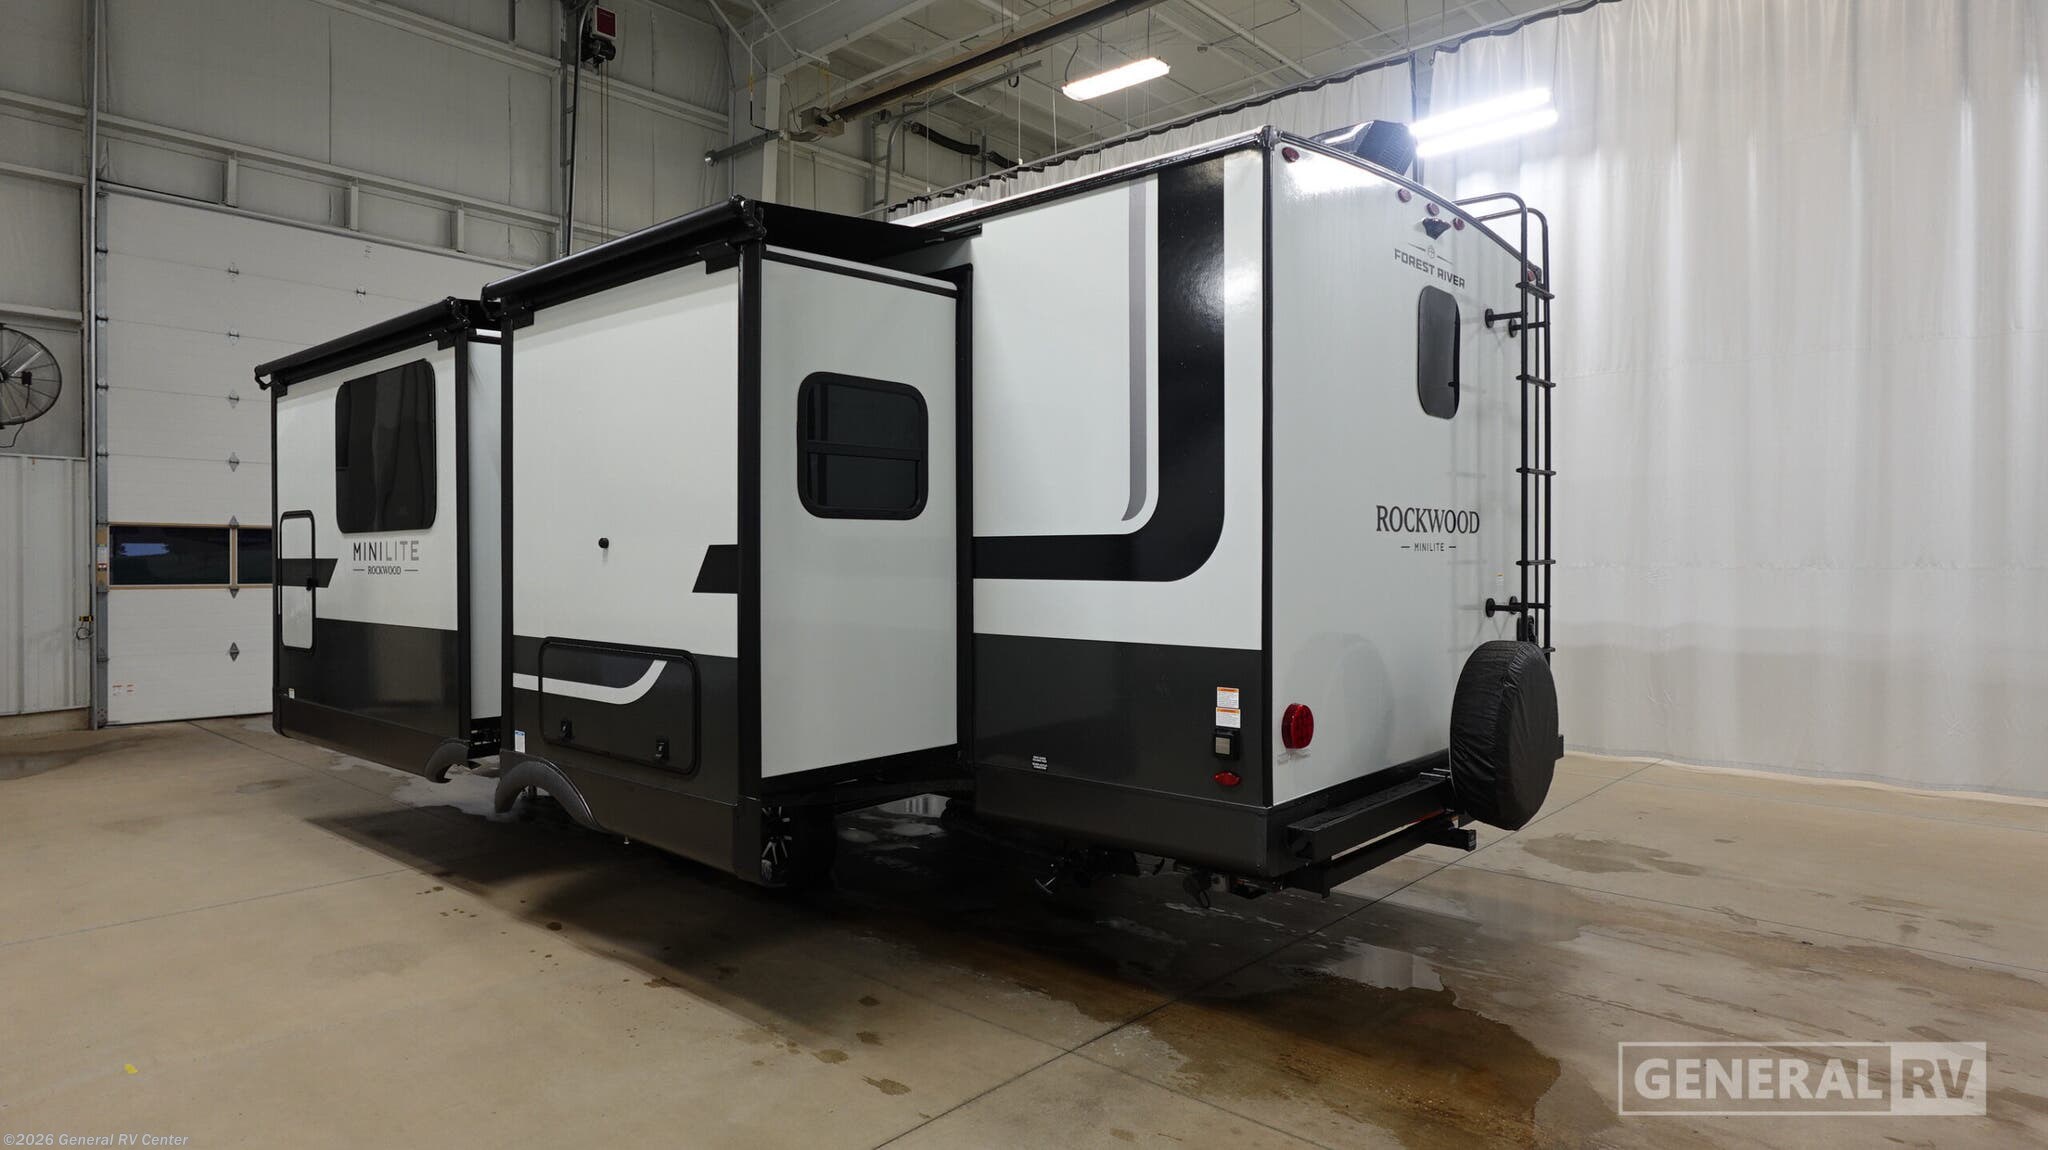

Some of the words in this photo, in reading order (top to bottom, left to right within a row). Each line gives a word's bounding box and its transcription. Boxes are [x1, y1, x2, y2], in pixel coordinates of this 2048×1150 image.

[1394, 248, 1435, 275] FOREST
[1437, 267, 1465, 289] RIVER
[1376, 505, 1480, 534] ROCKWOOD
[353, 541, 419, 561] MINILITE
[1414, 542, 1445, 552] MINILITE
[367, 565, 402, 575] ROCKWOOD
